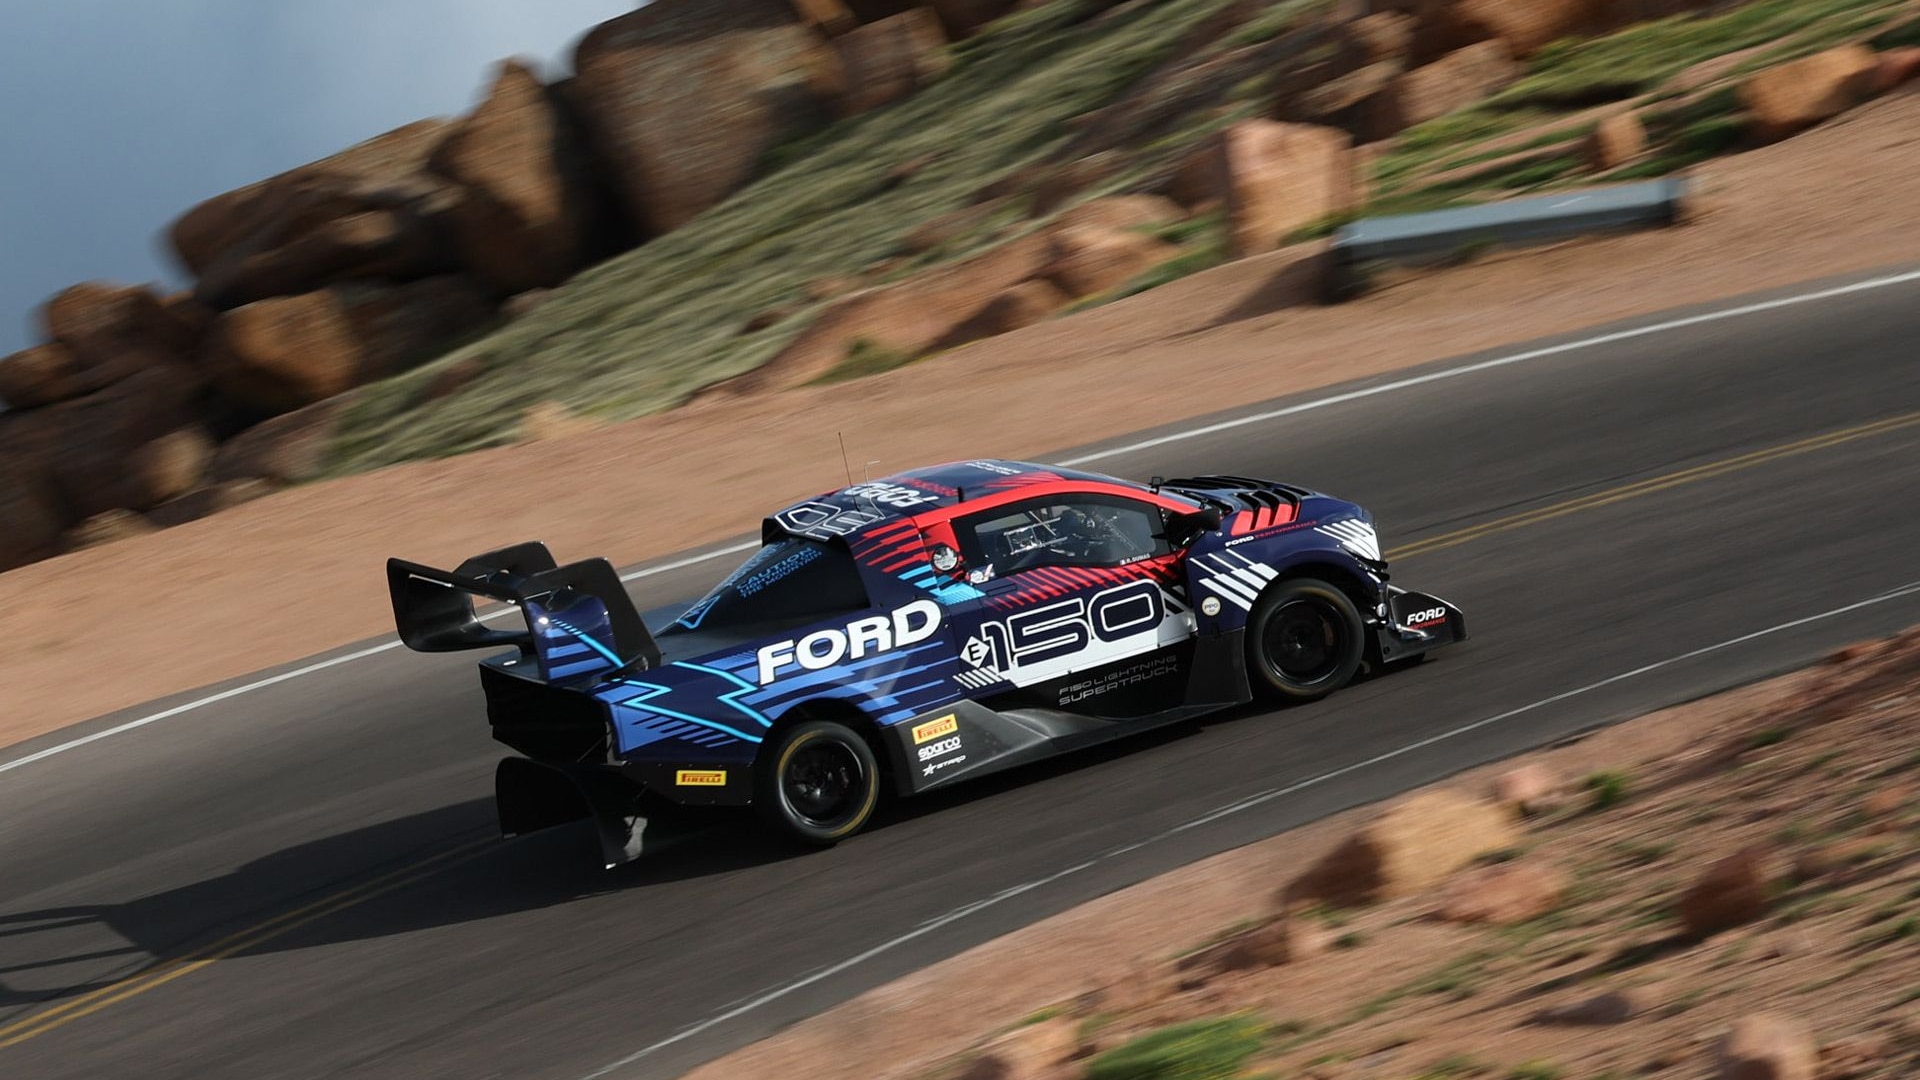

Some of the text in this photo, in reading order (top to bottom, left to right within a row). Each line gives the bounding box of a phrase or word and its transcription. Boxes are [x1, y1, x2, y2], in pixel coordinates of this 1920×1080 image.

[1225, 536, 1255, 547] FORD
[736, 547, 816, 589] CAUTION
[741, 584, 763, 598] THE
[968, 579, 1166, 674] E 150
[1407, 606, 1446, 625] FORD
[758, 600, 941, 685] FORD
[1058, 664, 1178, 706] SUPERTRUCK
[1059, 654, 1177, 695] F150 LIGHTNING
[917, 719, 953, 739] PIRELLI
[918, 736, 962, 761] sparco
[682, 773, 722, 783] PIRELLI
